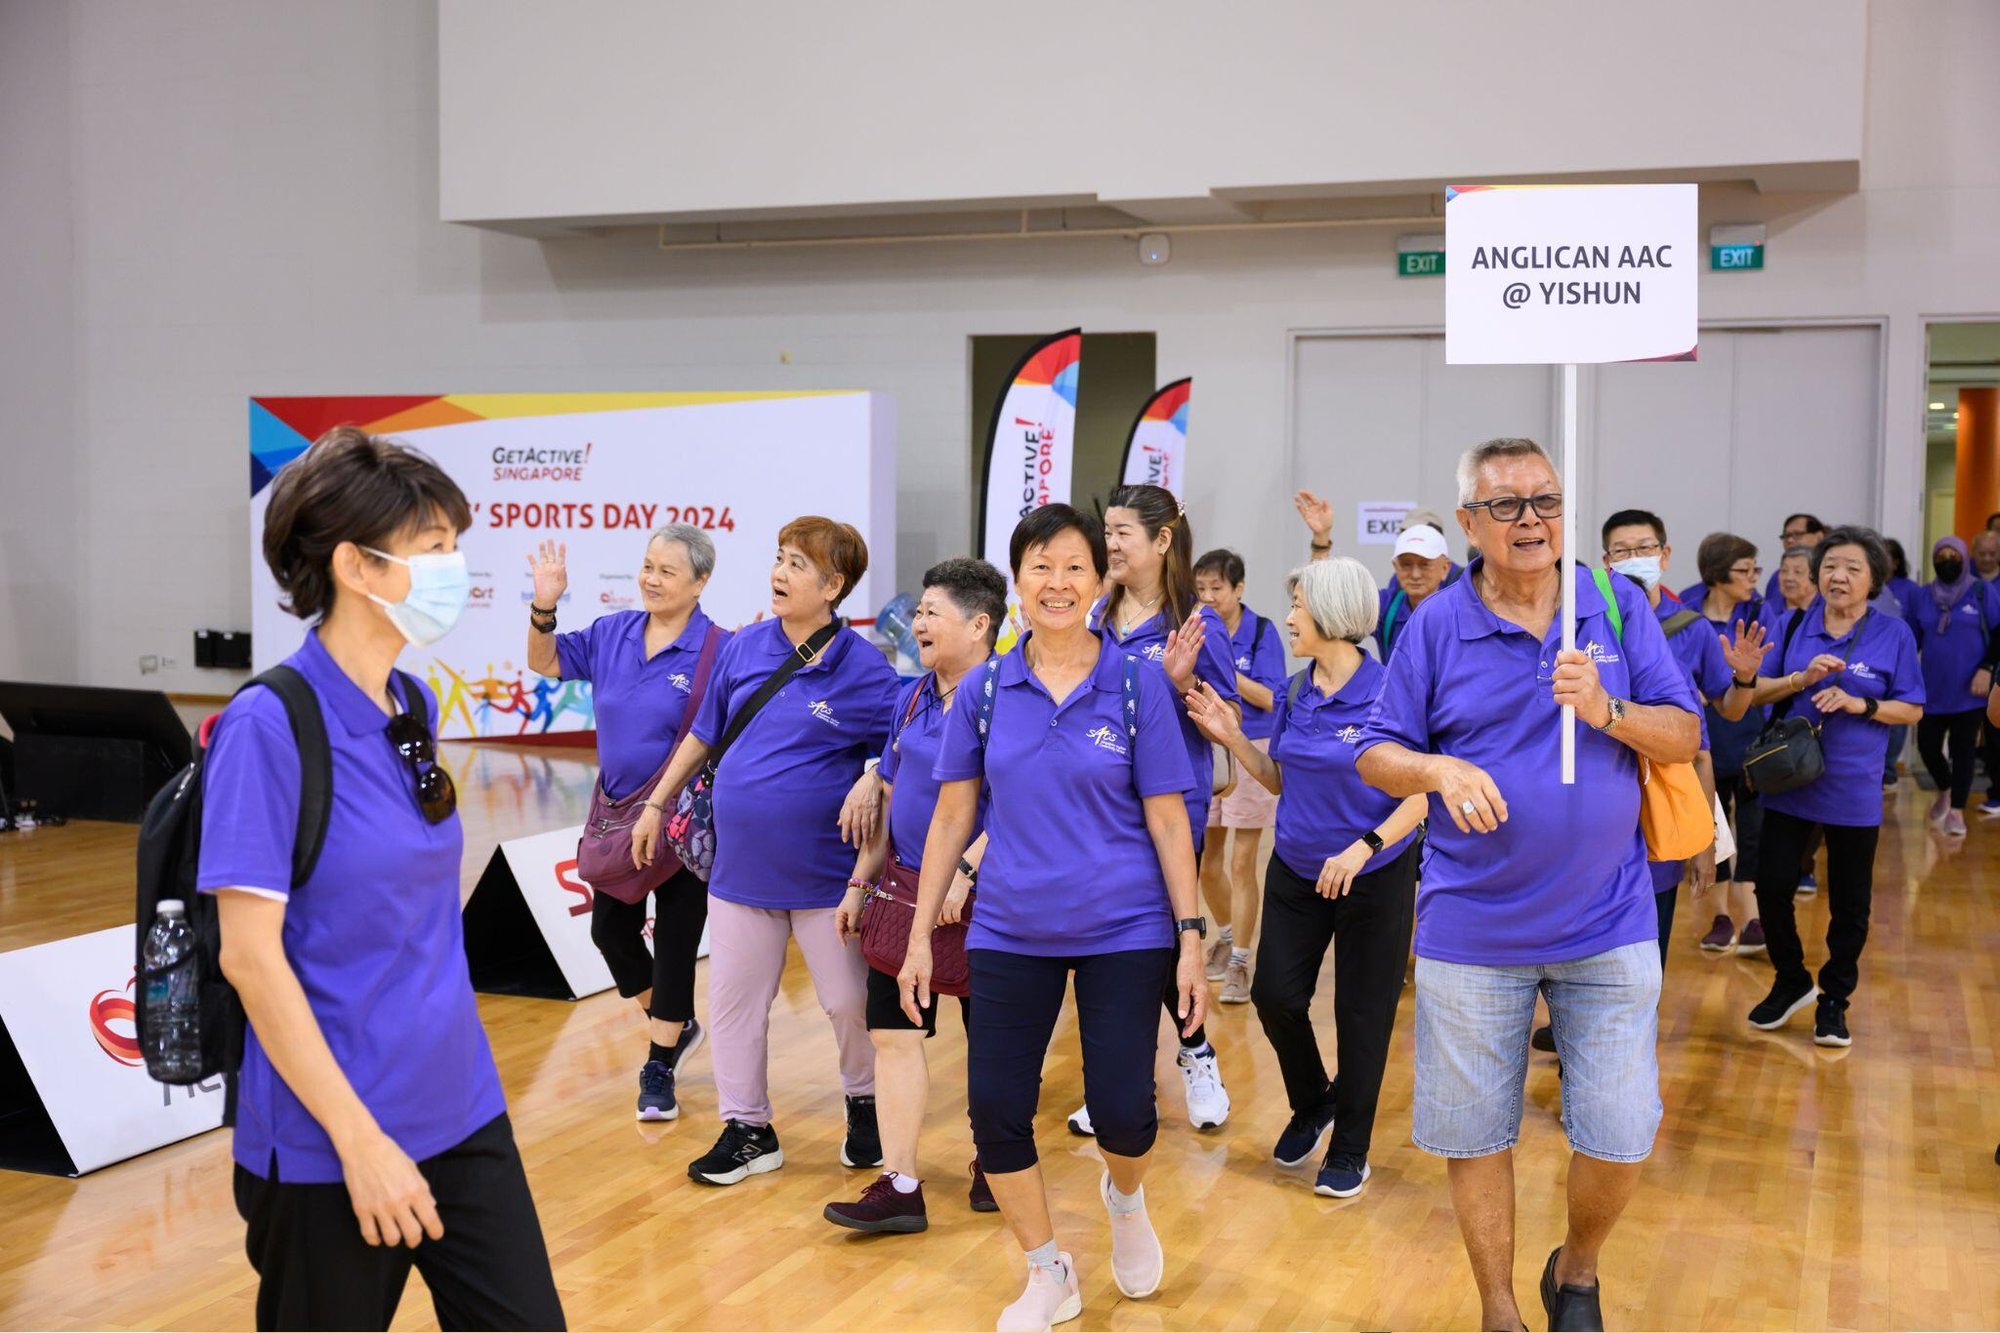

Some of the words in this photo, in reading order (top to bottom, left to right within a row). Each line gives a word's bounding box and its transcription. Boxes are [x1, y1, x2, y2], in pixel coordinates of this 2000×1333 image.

[1406, 254, 1439, 272] EXIT
[1471, 246, 1611, 269] ANGLICAN
[1618, 245, 1673, 268] AAC
[1720, 248, 1754, 267] EXIT
[1502, 282, 1531, 309] @
[1539, 281, 1641, 305] YISHUN
[493, 466, 583, 481] SINGAPORE
[489, 503, 594, 529] SPORTS
[603, 503, 658, 529] DAY
[666, 506, 735, 532] 2024
